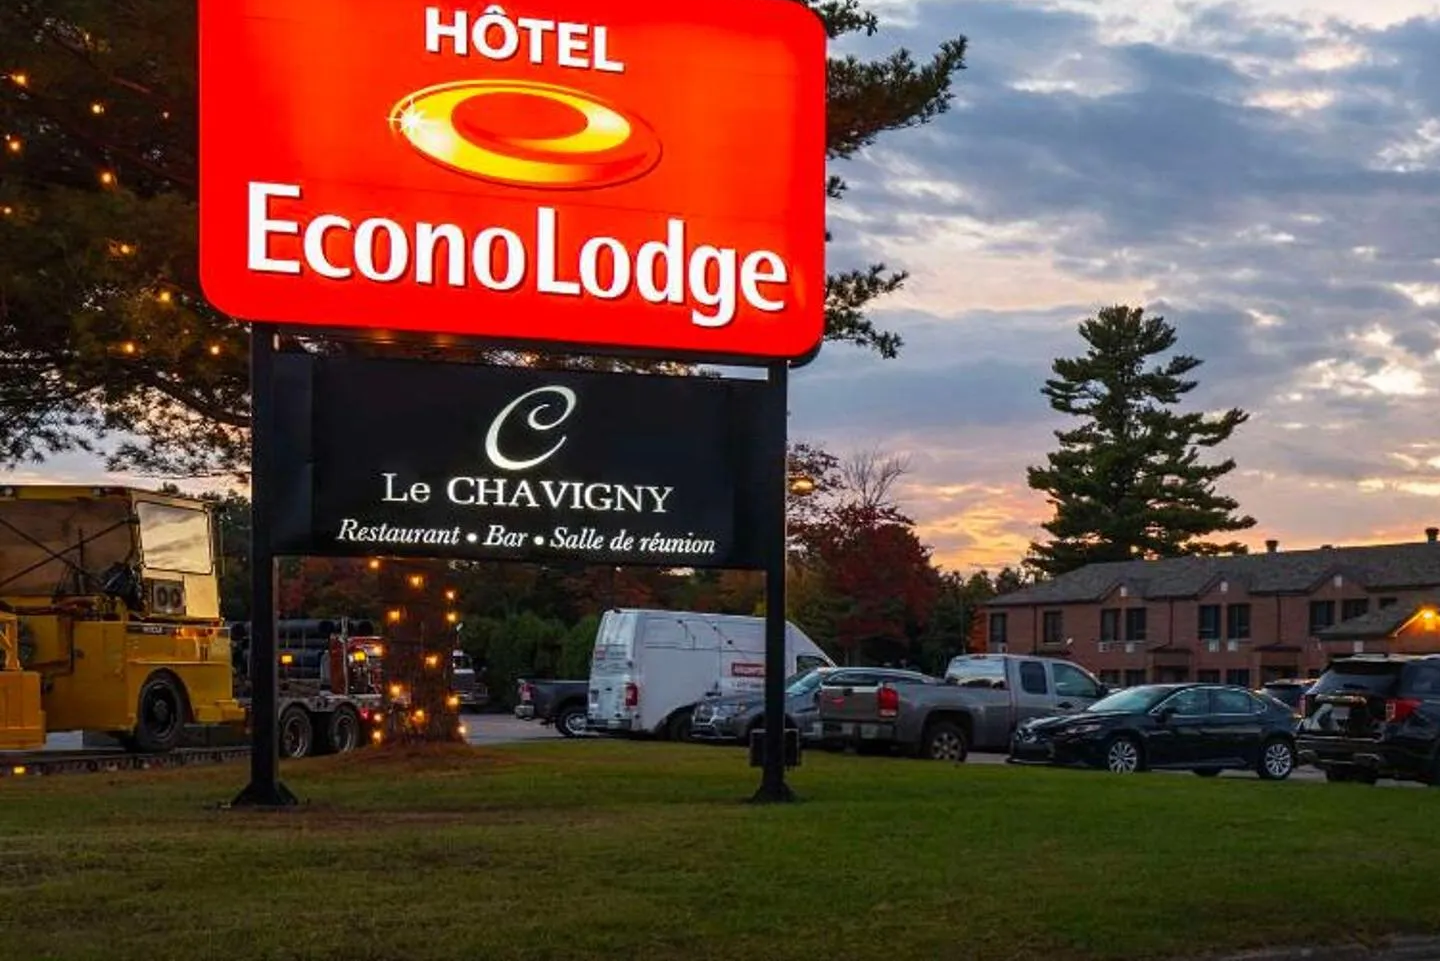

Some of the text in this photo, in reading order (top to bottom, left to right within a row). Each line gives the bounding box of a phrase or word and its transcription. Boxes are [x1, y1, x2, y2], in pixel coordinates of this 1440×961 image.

[425, 4, 624, 73] HÔTEL
[246, 181, 788, 328] EconoLodge
[382, 472, 675, 513] Le CHAVIGNY
[337, 518, 716, 555] Restaurant Bar Salle de réunion
